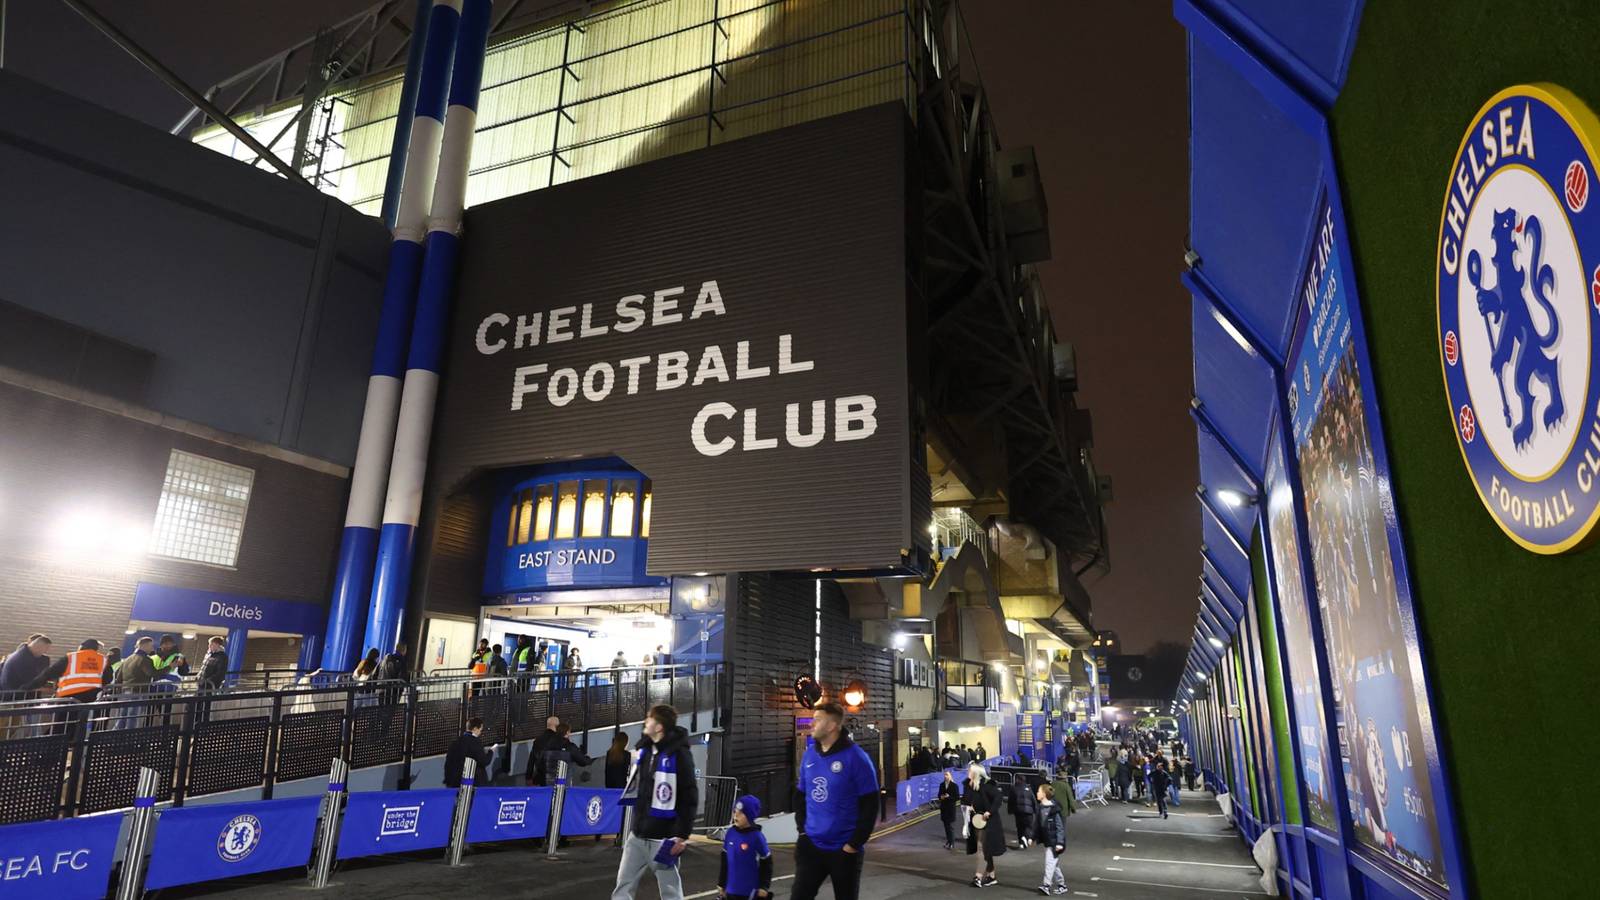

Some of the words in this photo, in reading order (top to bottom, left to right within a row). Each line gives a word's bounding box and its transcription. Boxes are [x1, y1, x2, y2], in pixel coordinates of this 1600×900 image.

[1443, 101, 1535, 275] CHELSEA
[475, 280, 726, 354] CHELSEA
[510, 334, 814, 411] FOOTBALL
[691, 394, 878, 457] CLUB
[1491, 475, 1575, 529] FOOTBALL
[1577, 398, 1600, 493] CL
[518, 550, 552, 569] EAST
[556, 548, 615, 566] STAND
[209, 601, 263, 621] Dickie's
[386, 818, 415, 829] bridge
[0, 855, 42, 880] EA
[52, 849, 91, 874] FC
